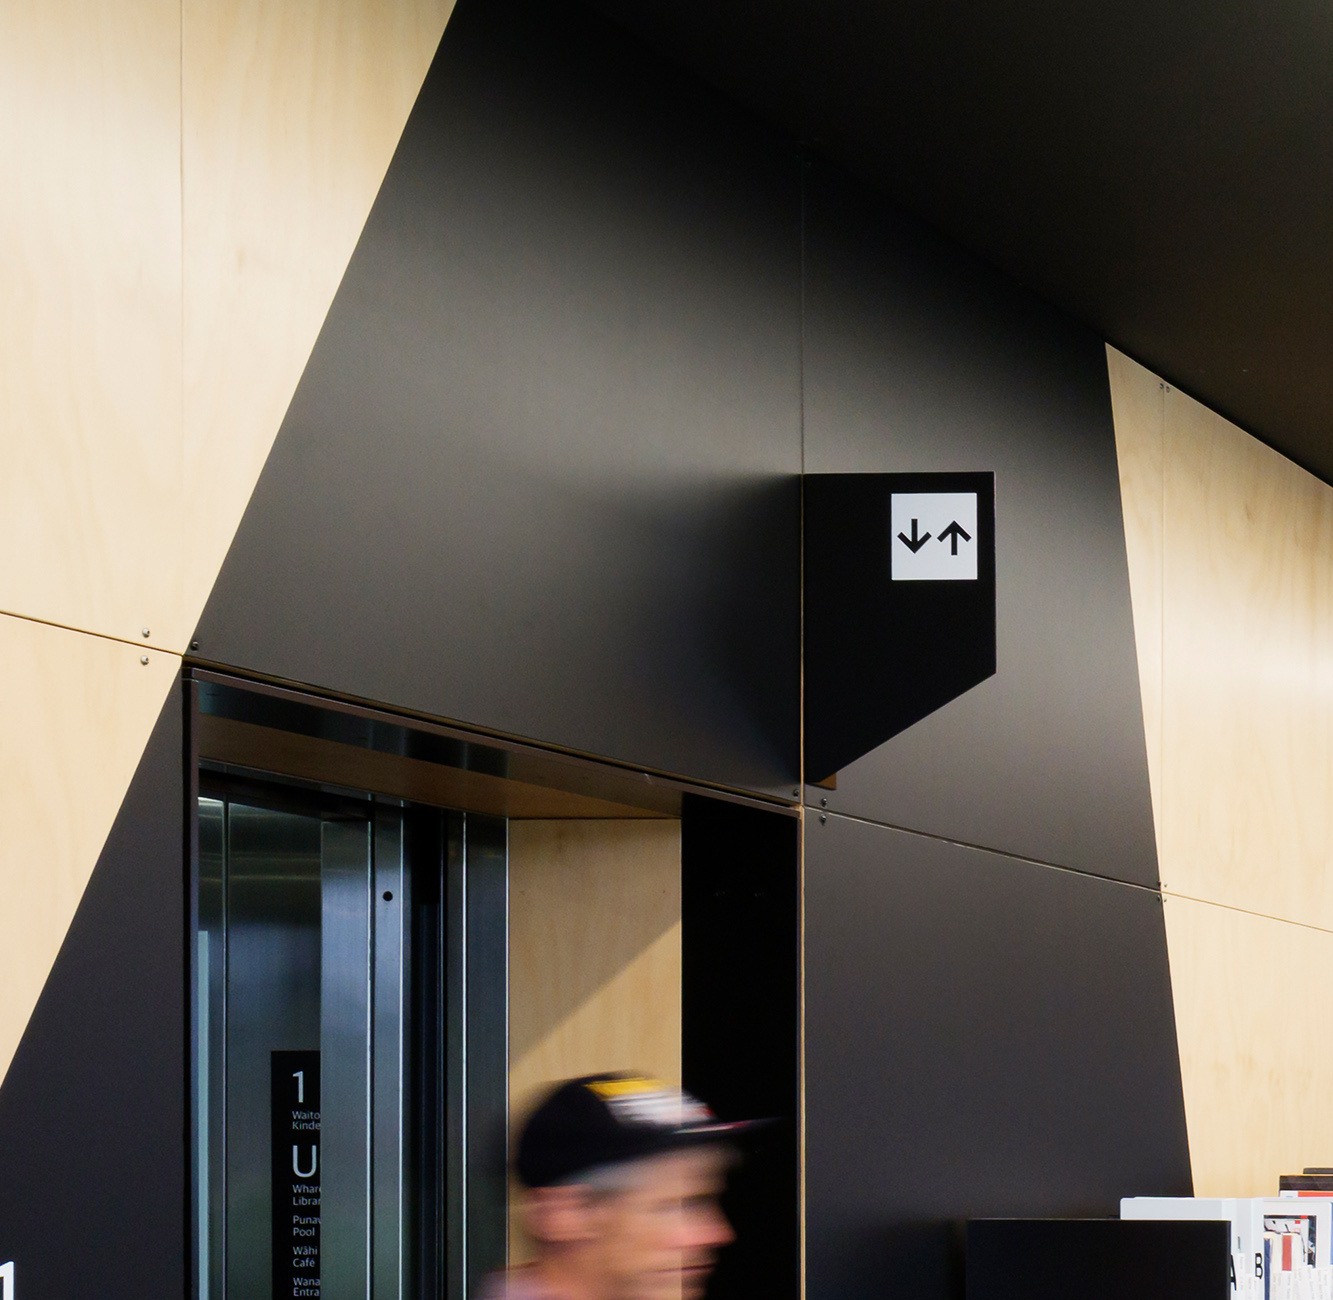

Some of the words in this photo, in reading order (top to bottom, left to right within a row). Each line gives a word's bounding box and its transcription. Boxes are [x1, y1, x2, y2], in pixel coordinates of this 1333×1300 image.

[292, 1070, 304, 1103] 1
[293, 1227, 316, 1236] Pool
[292, 1257, 316, 1267] Café
[1255, 1252, 1263, 1280] B
